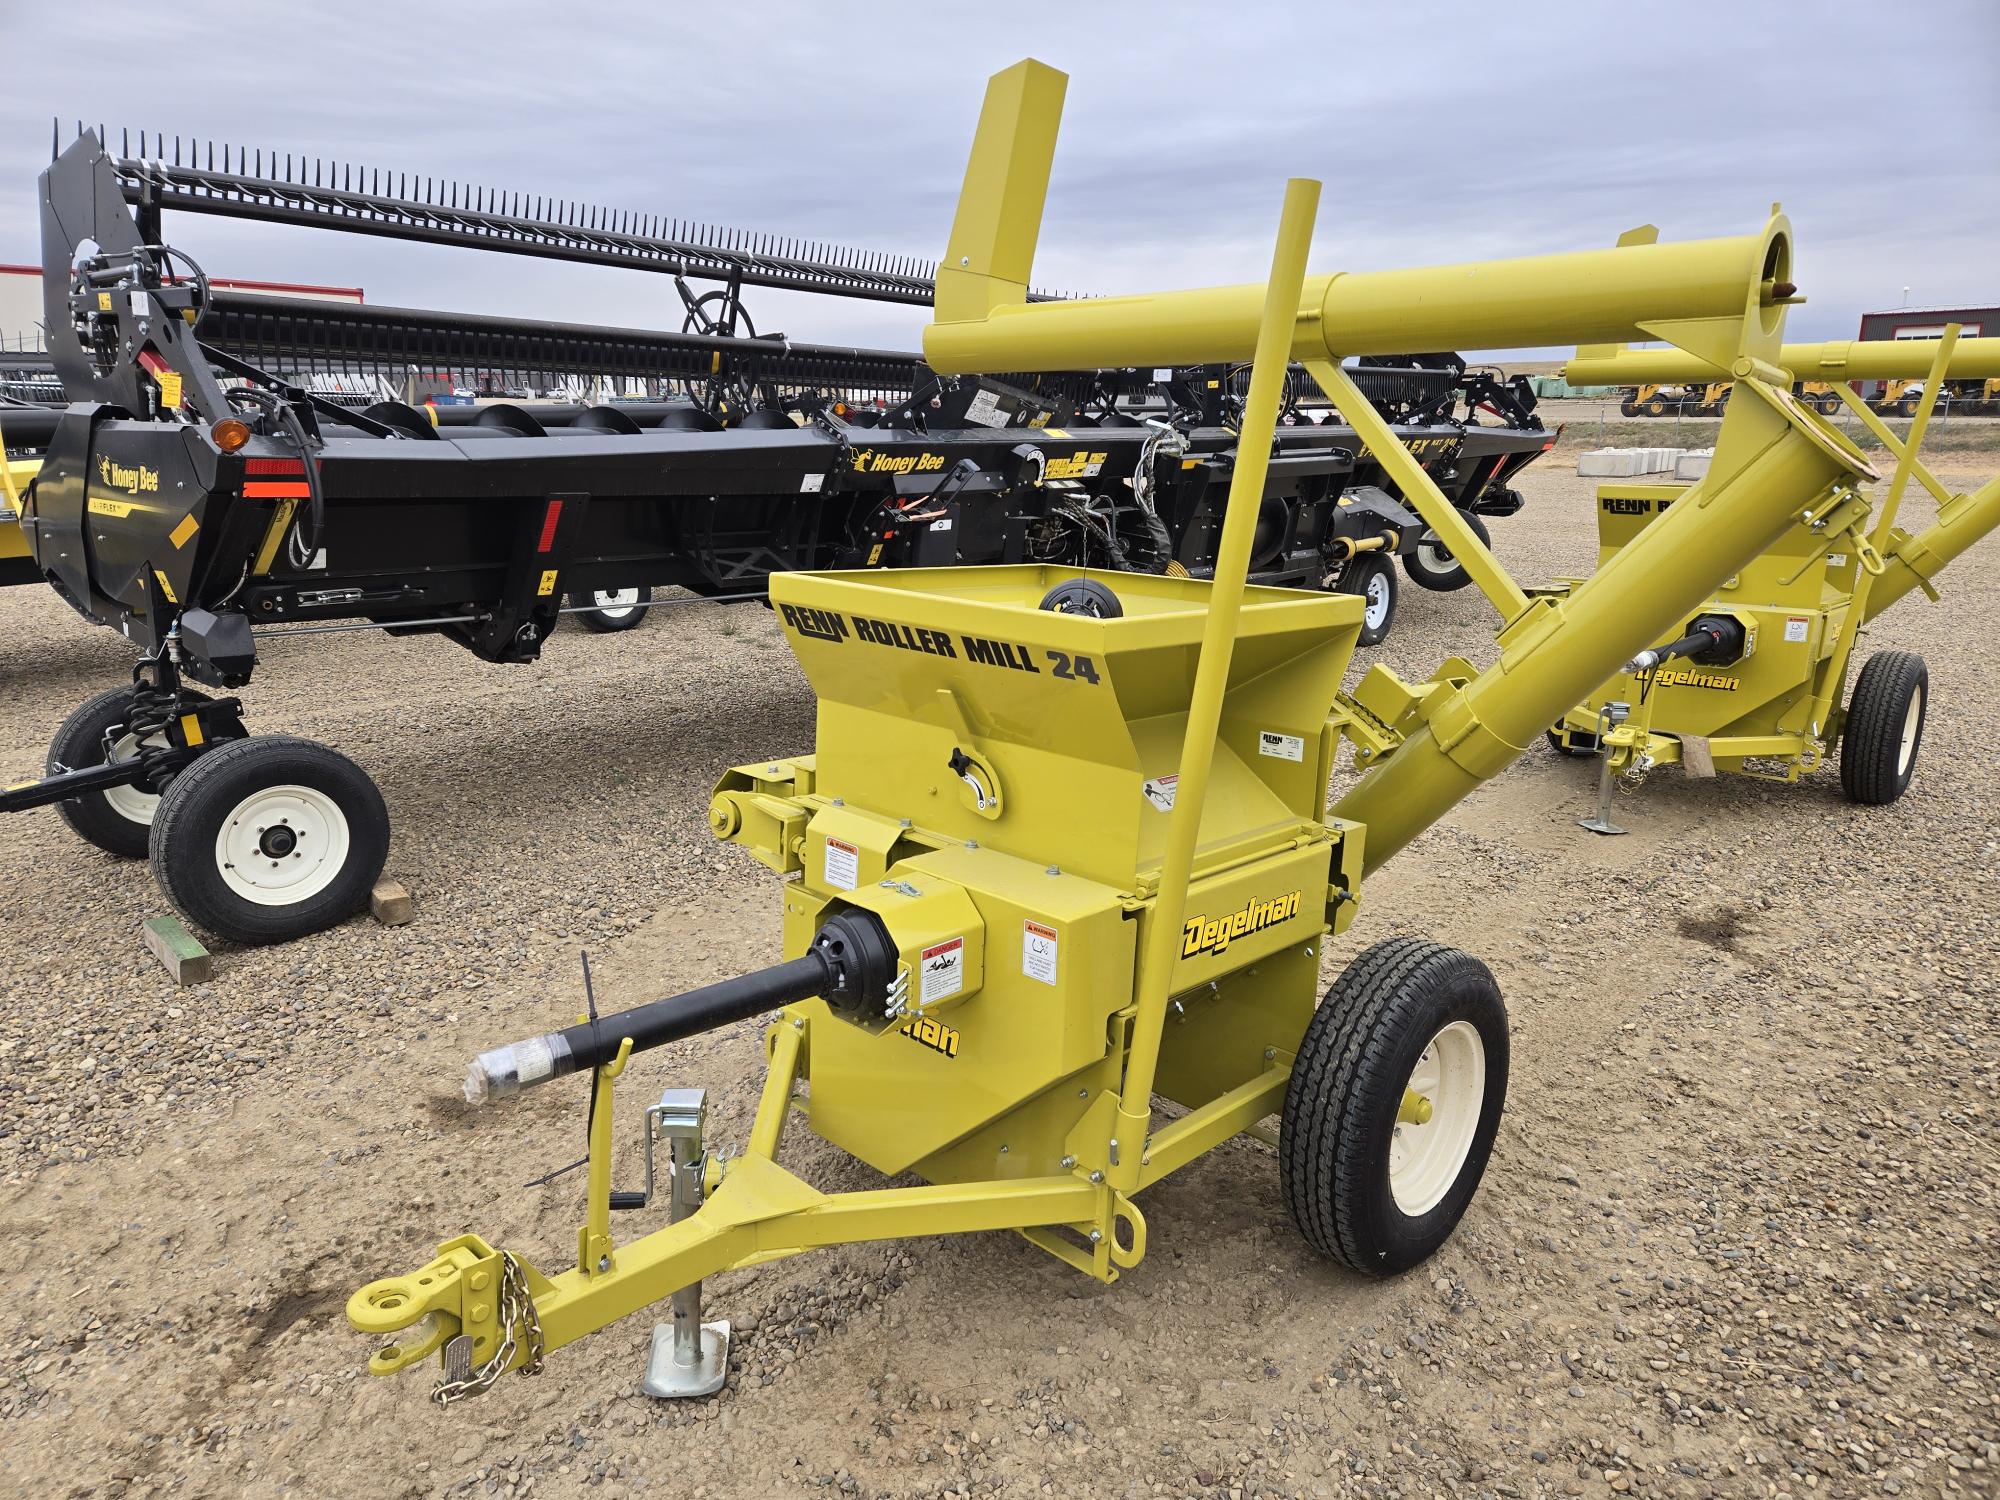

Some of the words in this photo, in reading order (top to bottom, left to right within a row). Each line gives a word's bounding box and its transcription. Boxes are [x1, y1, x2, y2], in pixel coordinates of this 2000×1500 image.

[870, 453, 918, 475] Honey
[915, 452, 945, 470] Bee
[111, 463, 139, 494] Honey
[139, 465, 158, 492] Bee
[1602, 498, 1651, 516] RENN
[779, 603, 850, 643] RENN
[851, 616, 957, 658] ROLLER
[961, 636, 1040, 673] MILL
[1047, 651, 1100, 685] 24
[1263, 733, 1283, 744] RENN
[1033, 926, 1056, 939] WARNING
[1181, 890, 1301, 960] Degelman
